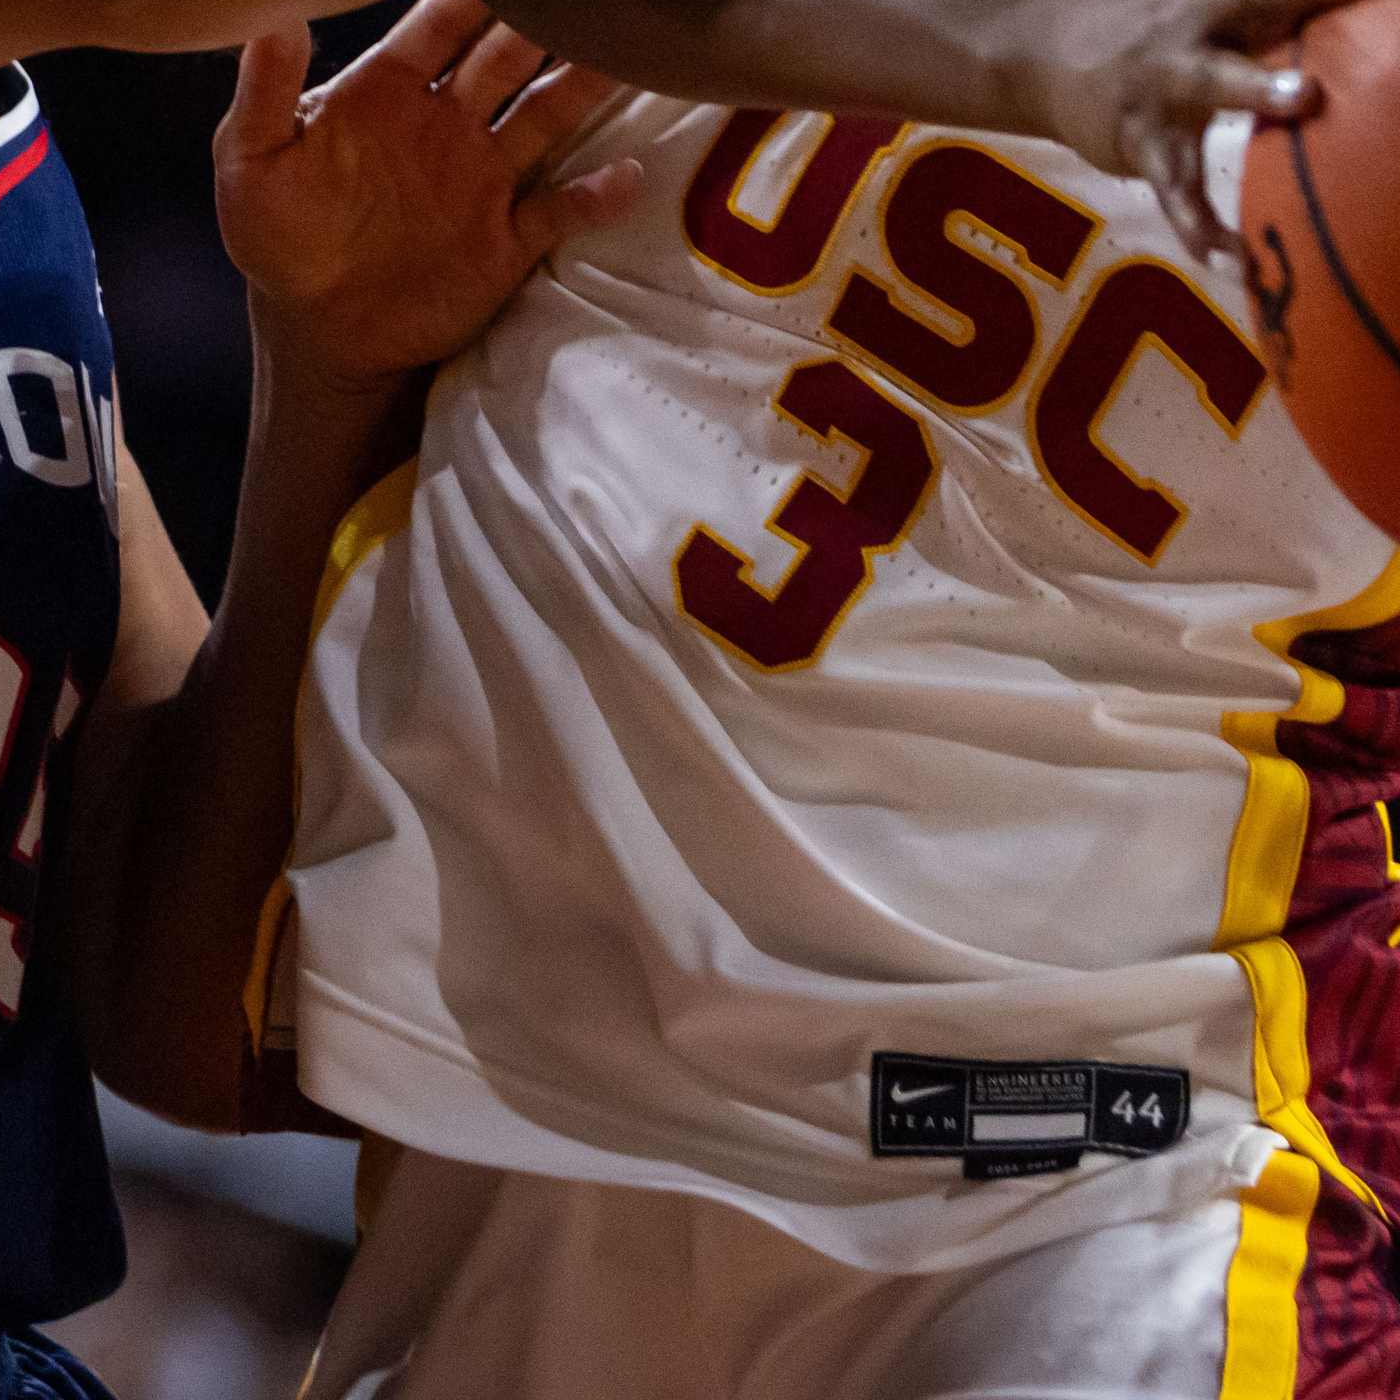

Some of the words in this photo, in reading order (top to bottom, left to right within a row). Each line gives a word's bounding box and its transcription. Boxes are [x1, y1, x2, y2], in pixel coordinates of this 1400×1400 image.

[683, 107, 1270, 567] USC
[672, 359, 942, 675] 3
[890, 1114, 958, 1130] TEAM
[1110, 1089, 1166, 1129] 44
